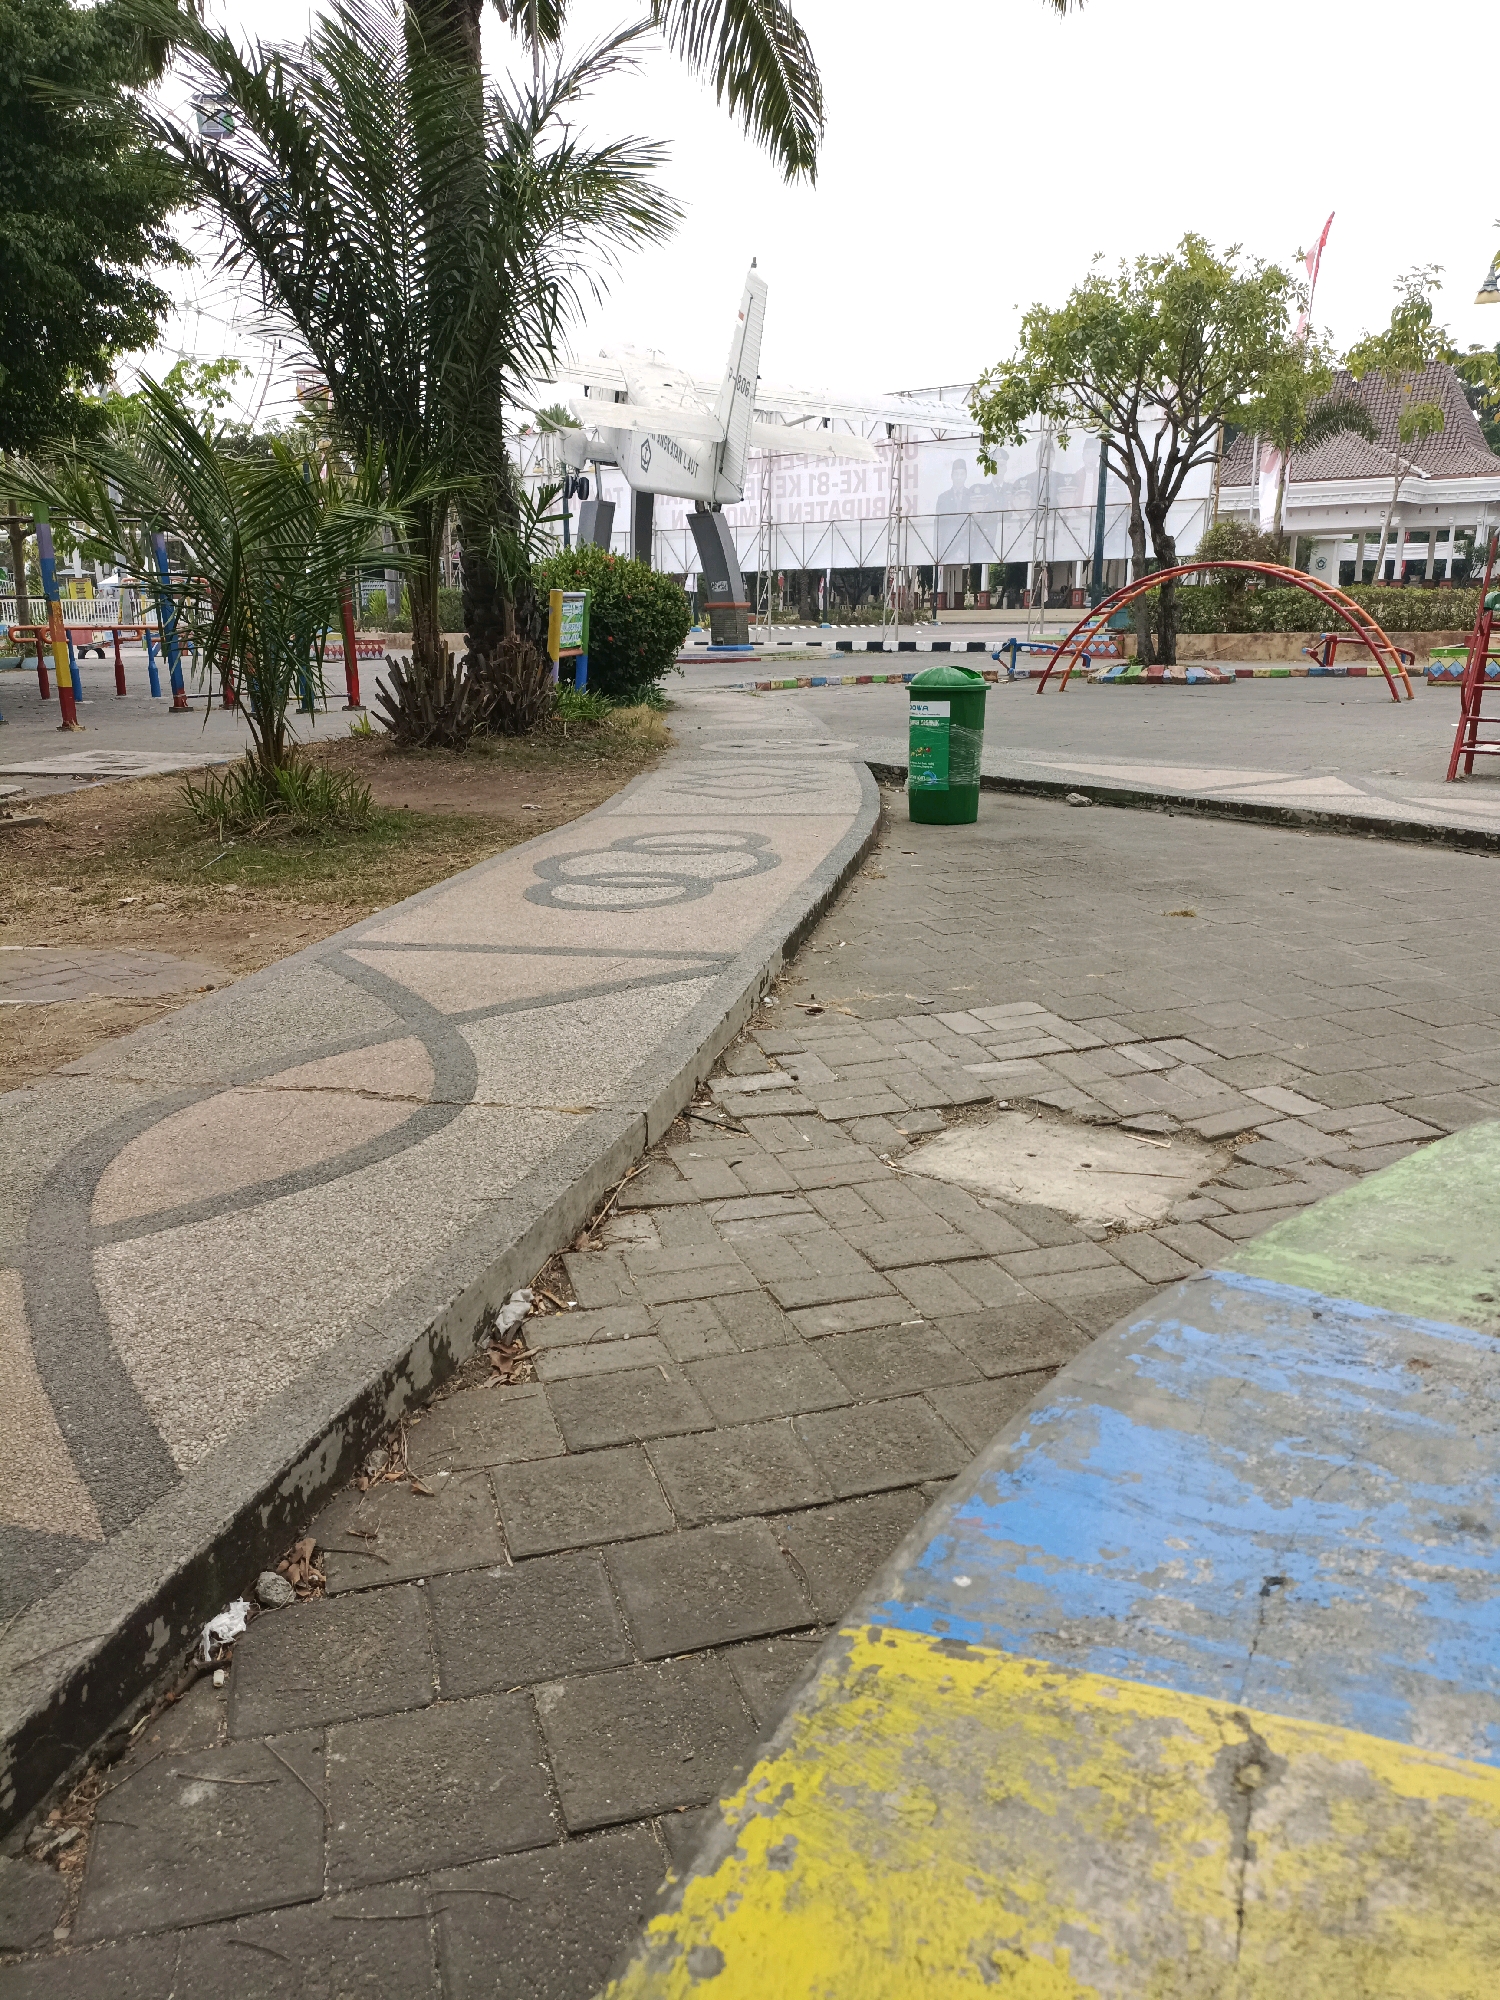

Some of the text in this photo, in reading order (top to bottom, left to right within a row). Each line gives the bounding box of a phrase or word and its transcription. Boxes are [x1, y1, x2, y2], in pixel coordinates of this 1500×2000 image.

[727, 366, 751, 397] P-806
[656, 434, 699, 478] ANGKATAN LAUT
